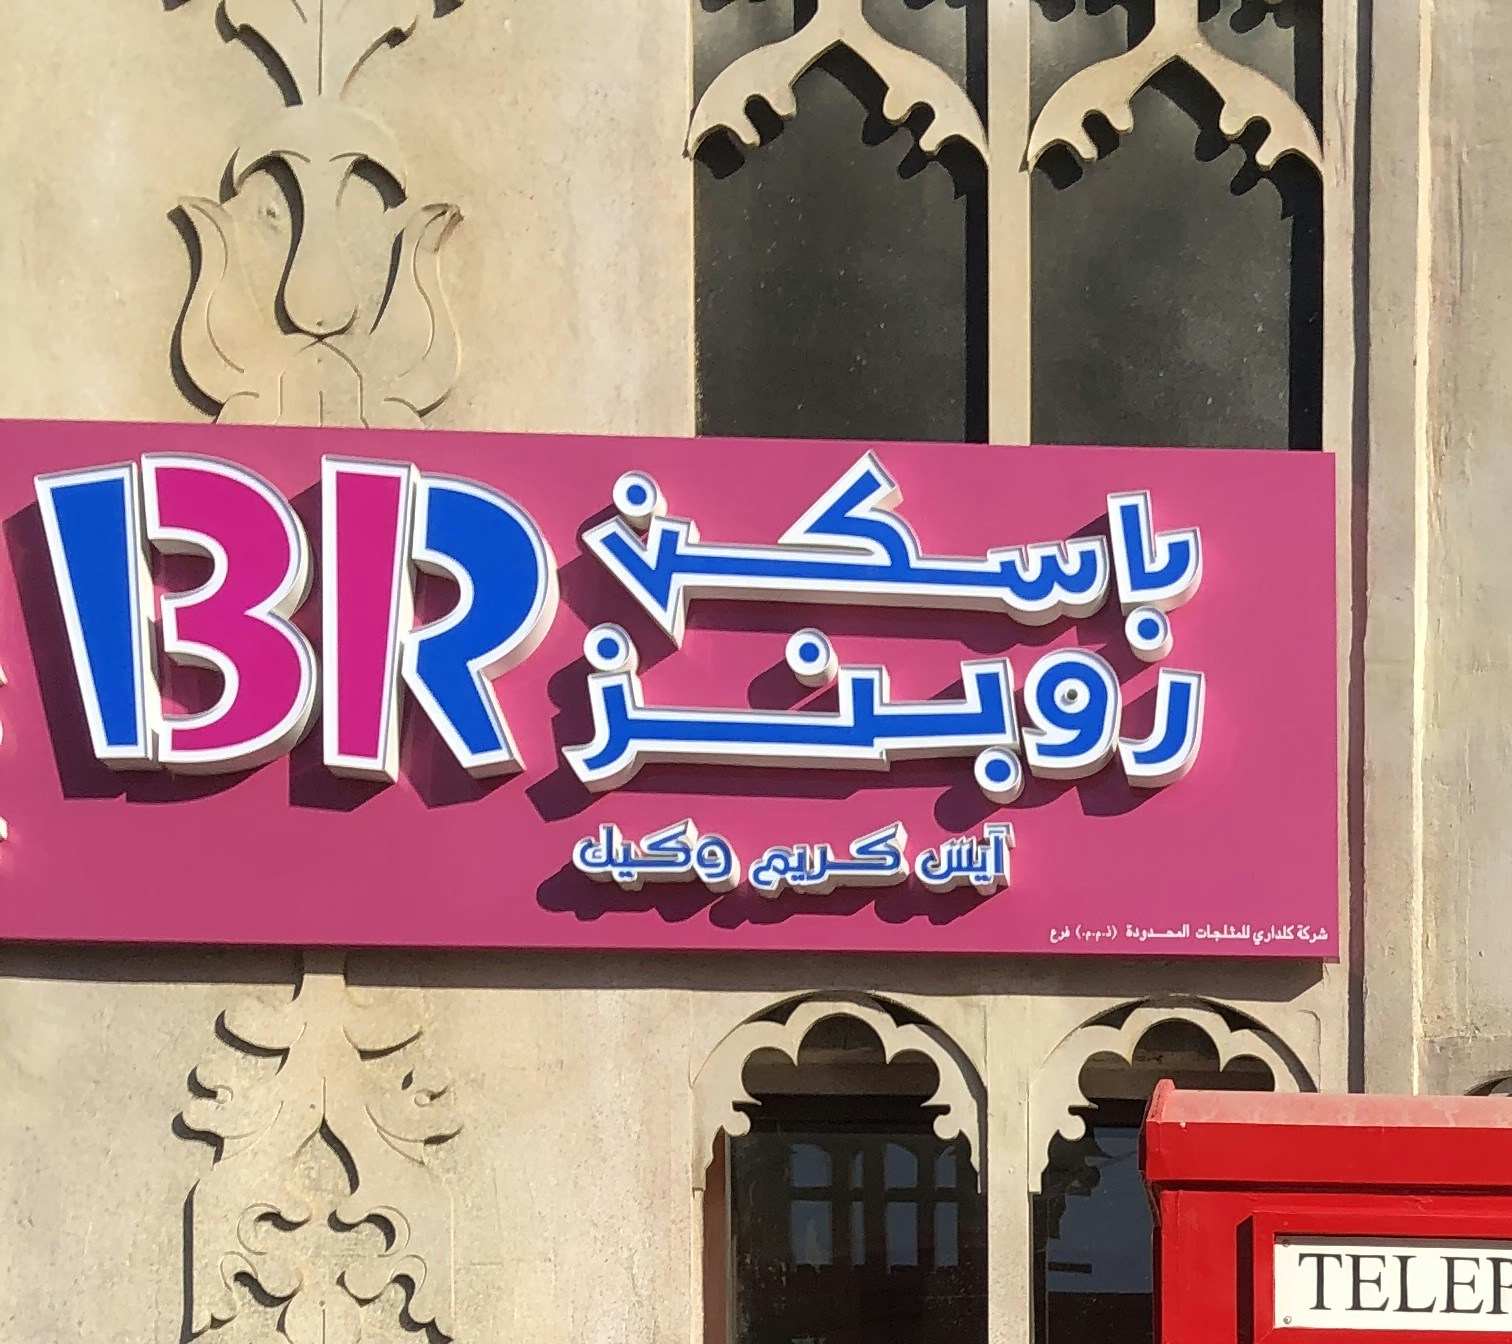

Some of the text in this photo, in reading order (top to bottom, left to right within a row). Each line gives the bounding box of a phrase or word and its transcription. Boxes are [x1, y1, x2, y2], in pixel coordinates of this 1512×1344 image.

[582, 450, 1204, 660] باسكن
[35, 452, 560, 781] BR
[562, 623, 1206, 802] روبنز
[749, 821, 907, 893] كريم
[914, 822, 1015, 890] آيس
[1049, 925, 1071, 944] فرع
[1252, 924, 1295, 946] كلداري
[1296, 924, 1329, 944] شركة
